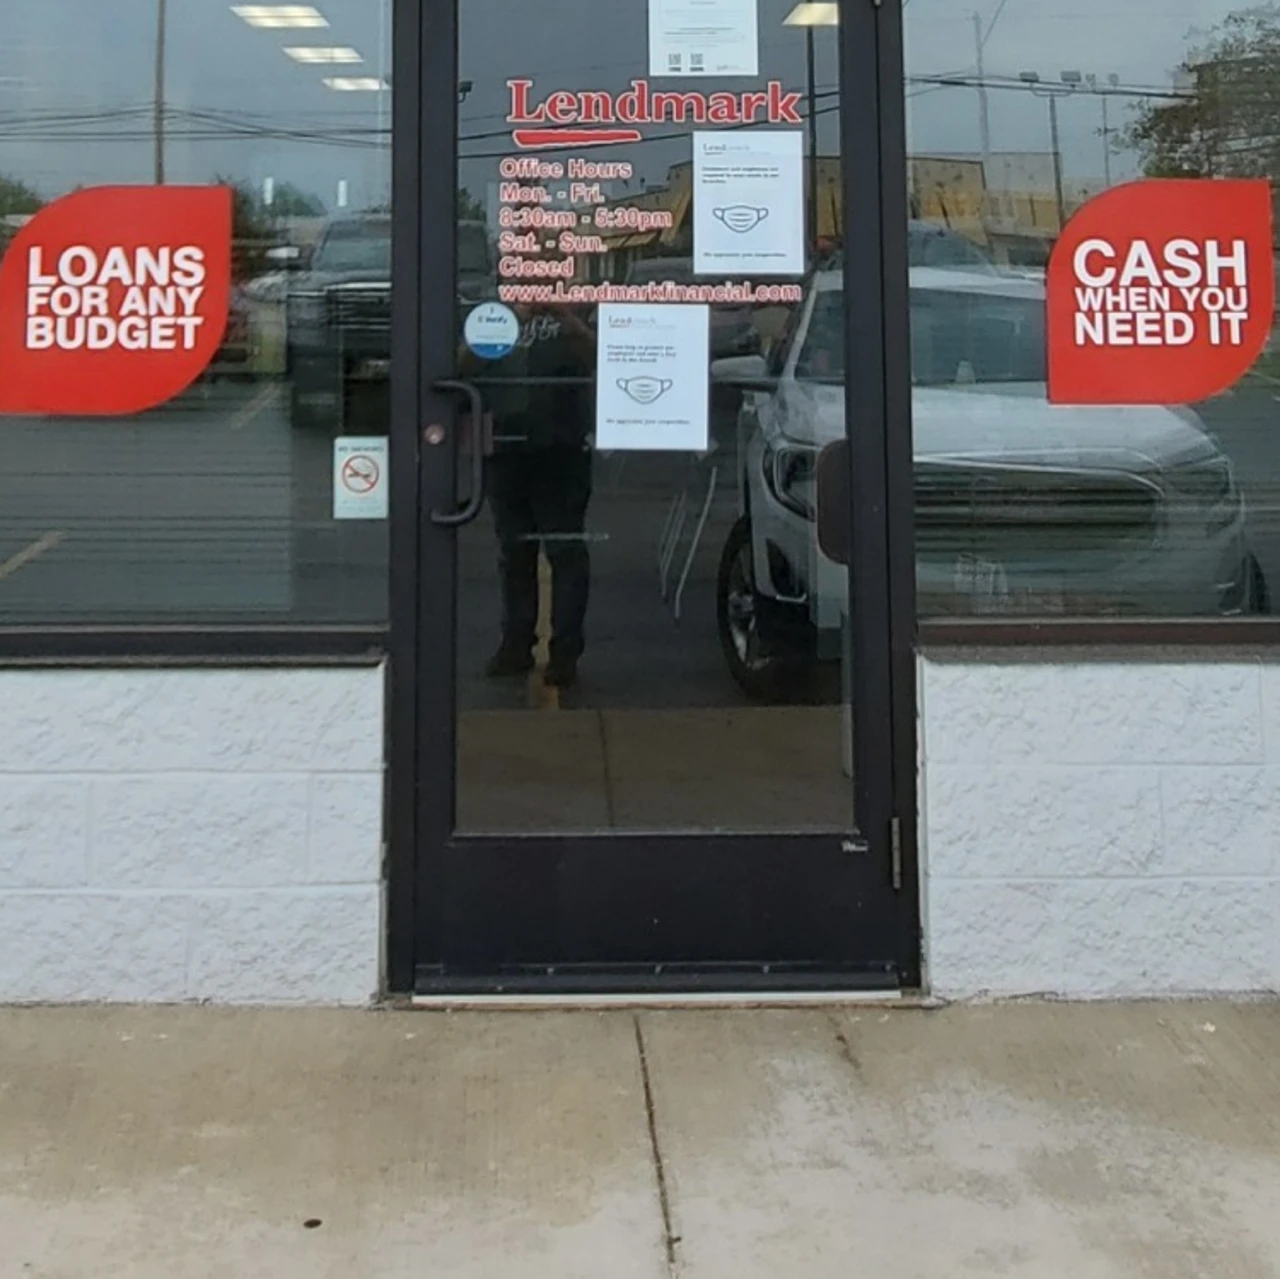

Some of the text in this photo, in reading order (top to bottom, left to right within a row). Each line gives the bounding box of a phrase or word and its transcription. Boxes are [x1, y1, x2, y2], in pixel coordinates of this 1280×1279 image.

[506, 80, 803, 122] Lendmark
[499, 158, 632, 178] Office Hours
[499, 182, 552, 202] Mon.
[571, 183, 605, 203] Fri.
[499, 206, 576, 227] 8:30am
[594, 207, 672, 231] 5:30pm
[499, 232, 541, 252] Sat.
[559, 231, 608, 252] Sun.
[28, 245, 206, 287] LOANS
[498, 256, 574, 277] Closed
[1073, 238, 1247, 288] CASH
[27, 285, 204, 316] FOR ANY
[498, 280, 802, 302] www.Lendmarkfinancial.com
[1075, 287, 1248, 312] WHEN YOU
[26, 316, 204, 350] BUDGET
[1074, 312, 1248, 345] NEED IT
